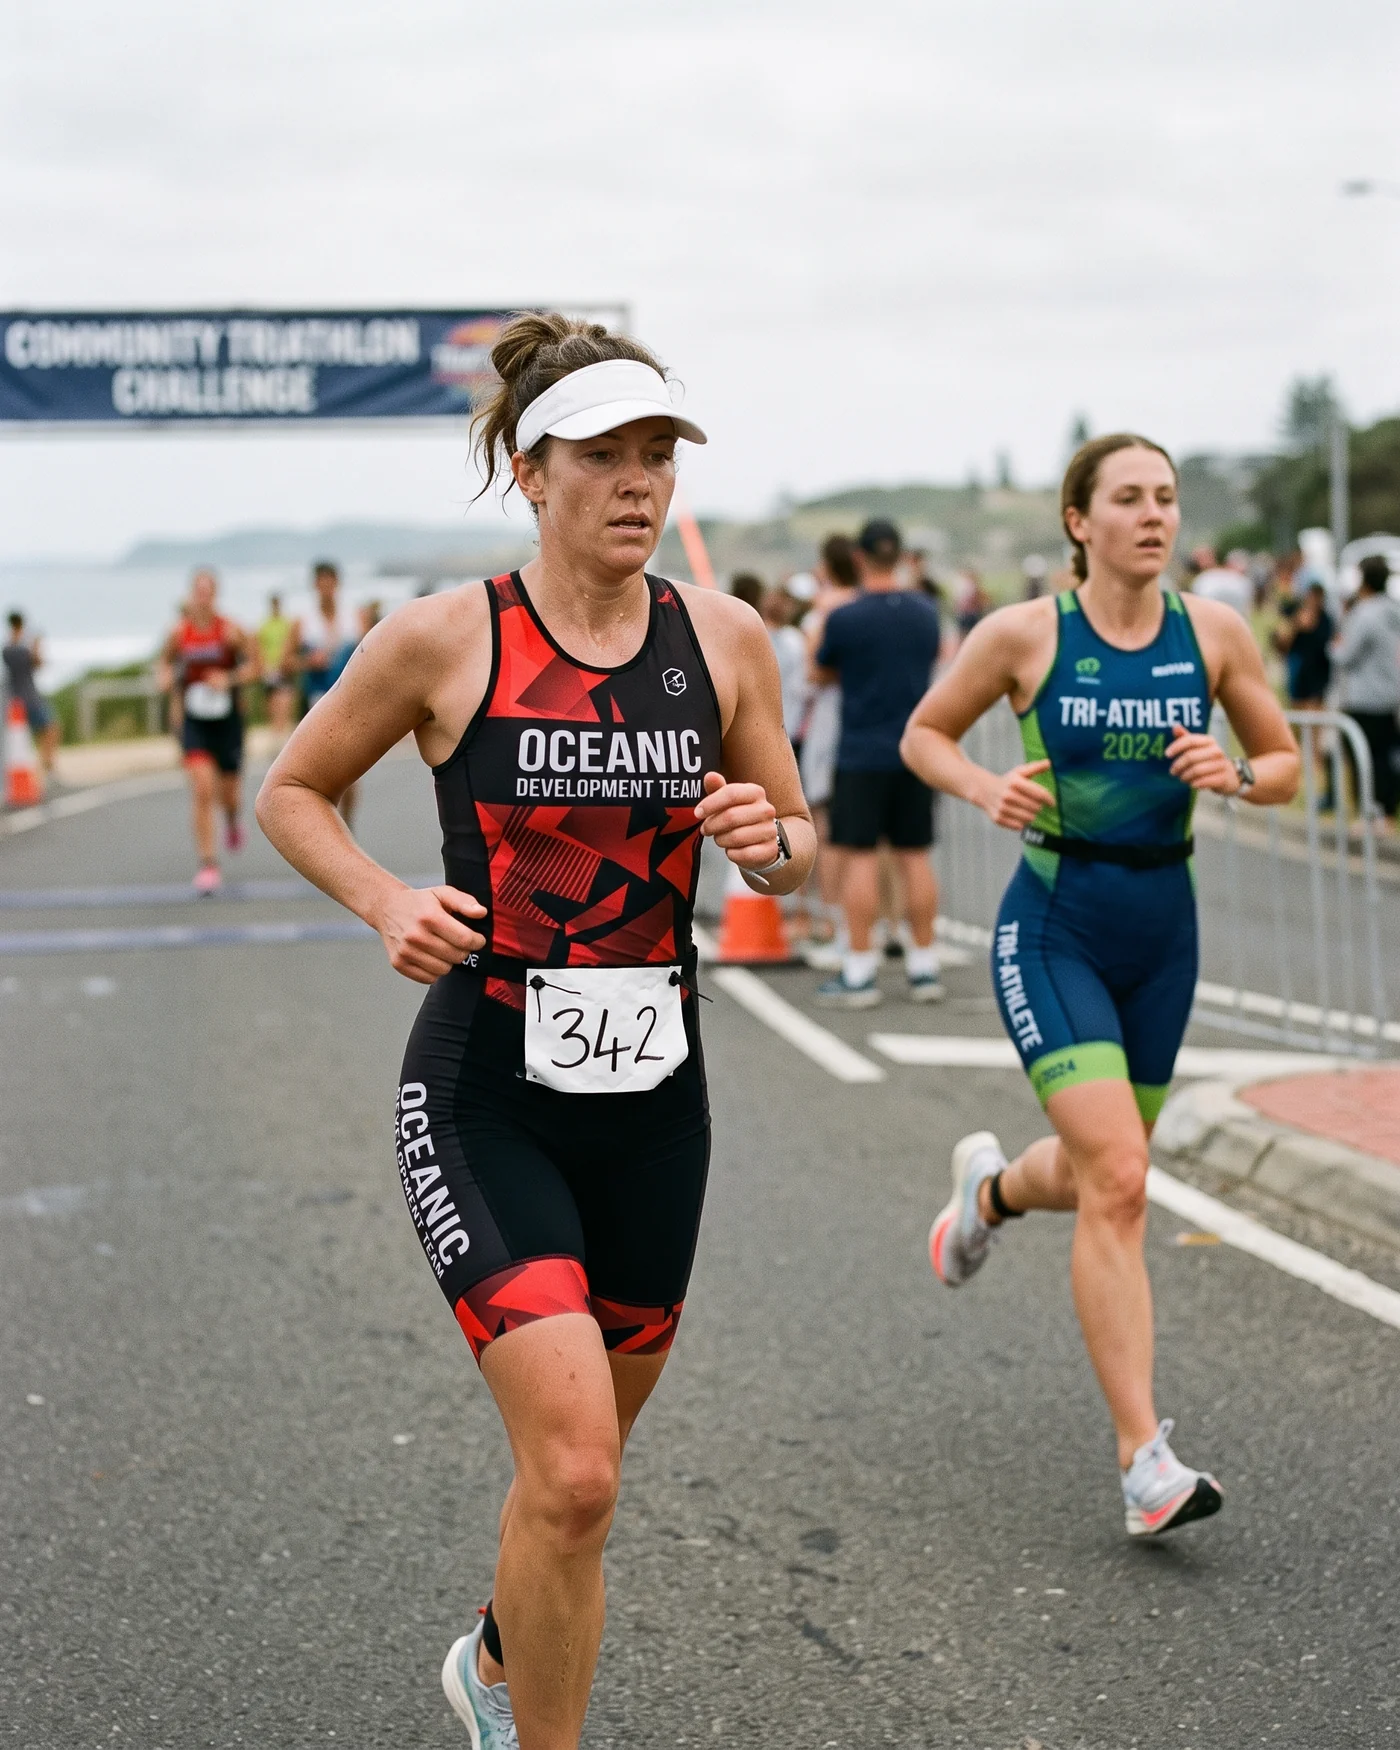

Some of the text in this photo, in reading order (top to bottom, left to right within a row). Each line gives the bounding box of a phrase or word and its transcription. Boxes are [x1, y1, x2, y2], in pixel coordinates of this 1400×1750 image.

[5, 320, 220, 369] COMMUNITY
[112, 367, 316, 415] CHALLENGE
[1059, 696, 1202, 729] TRI-ATHLETE
[518, 728, 702, 774] OCEANIC
[1103, 733, 1165, 761] 2024
[516, 777, 701, 799] DEVELOPMENT TEAM
[996, 920, 1043, 1053] TRI-ATHLETE
[551, 1005, 665, 1073] 342
[400, 1082, 470, 1266] OCEANIC
[422, 1231, 445, 1279] TEAM
